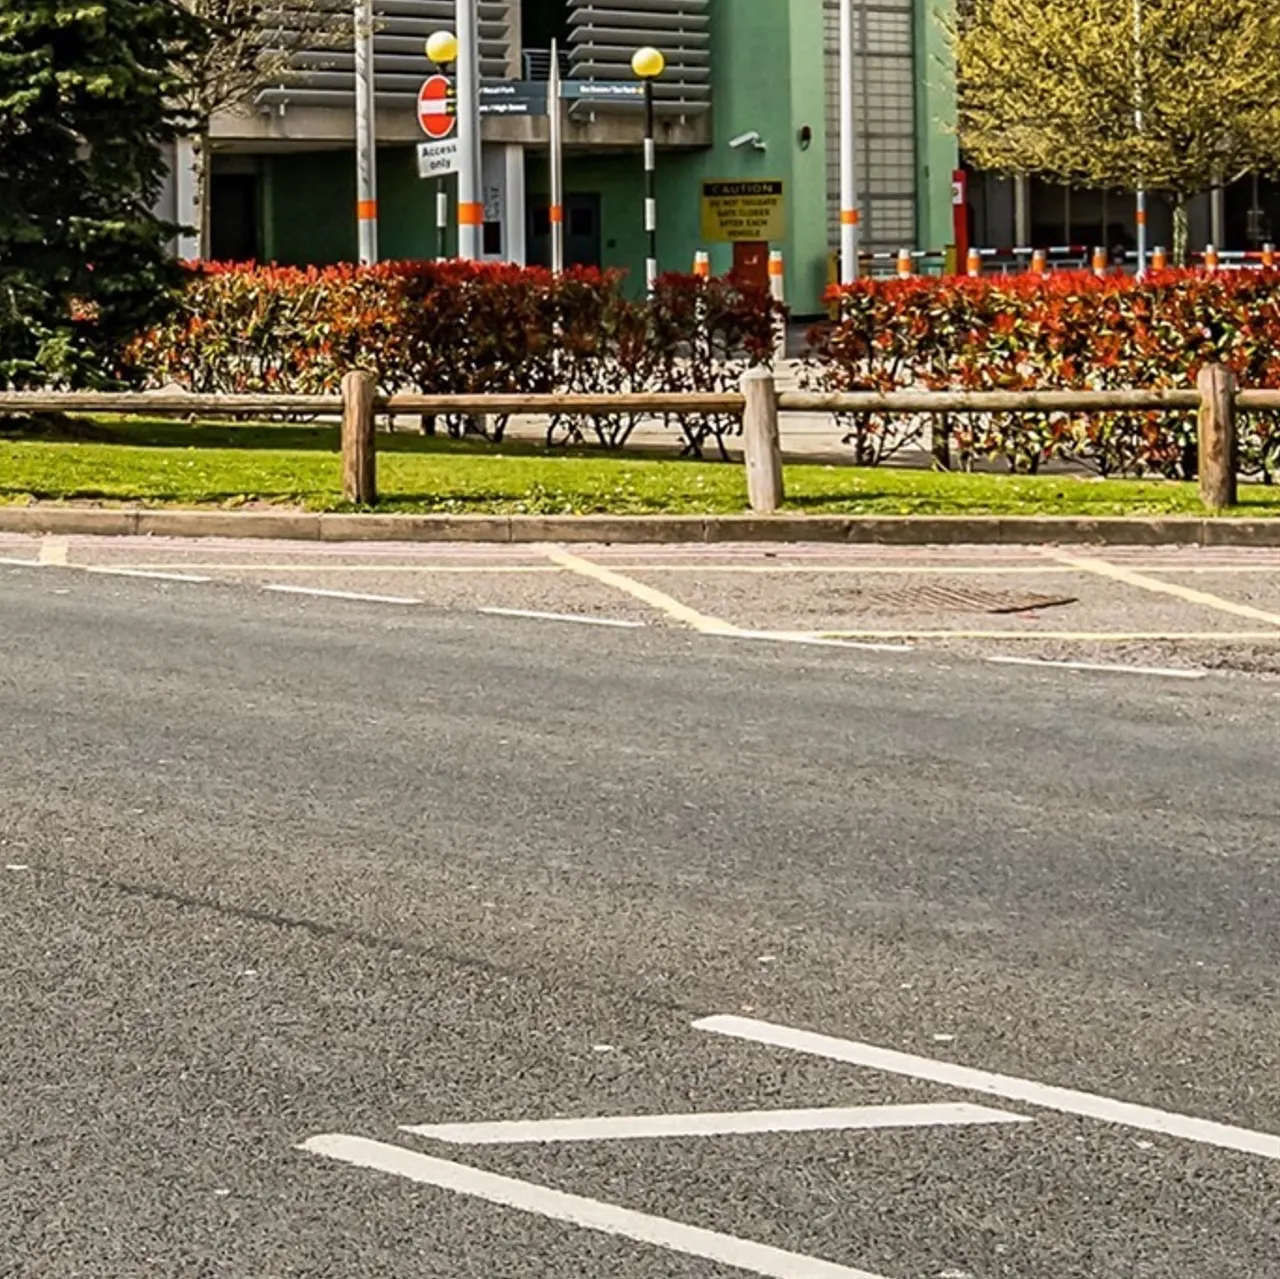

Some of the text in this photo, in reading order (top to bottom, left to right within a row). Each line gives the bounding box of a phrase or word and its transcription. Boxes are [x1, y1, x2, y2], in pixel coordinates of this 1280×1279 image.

[422, 144, 457, 157] Access
[429, 158, 451, 170] only
[711, 184, 774, 194] CAUTION
